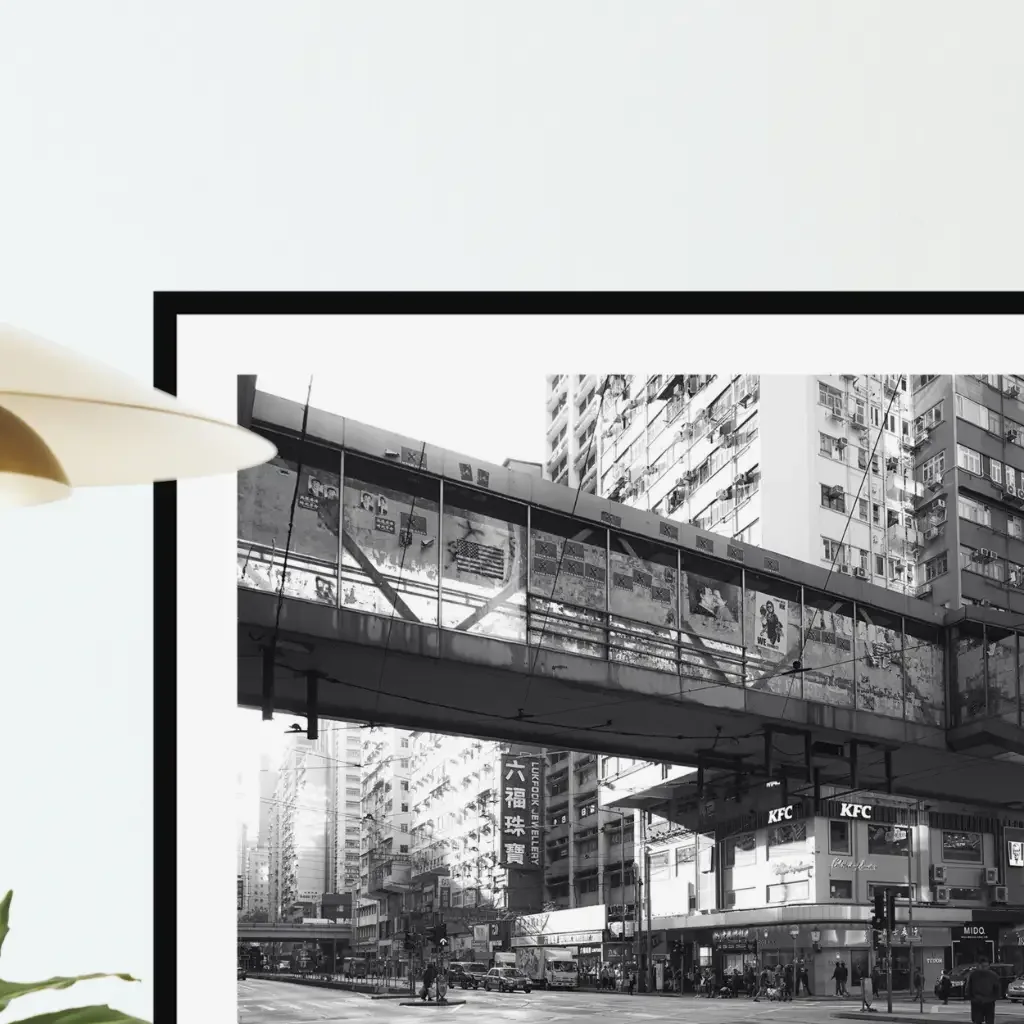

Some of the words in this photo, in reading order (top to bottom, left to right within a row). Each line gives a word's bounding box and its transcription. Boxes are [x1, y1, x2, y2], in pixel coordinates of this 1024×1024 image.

[531, 762, 540, 806] LUKFOOK
[504, 760, 526, 865] 六福珠寶
[767, 805, 793, 824] KFC
[840, 803, 872, 819] KFC
[531, 809, 540, 865] JEWELLERY
